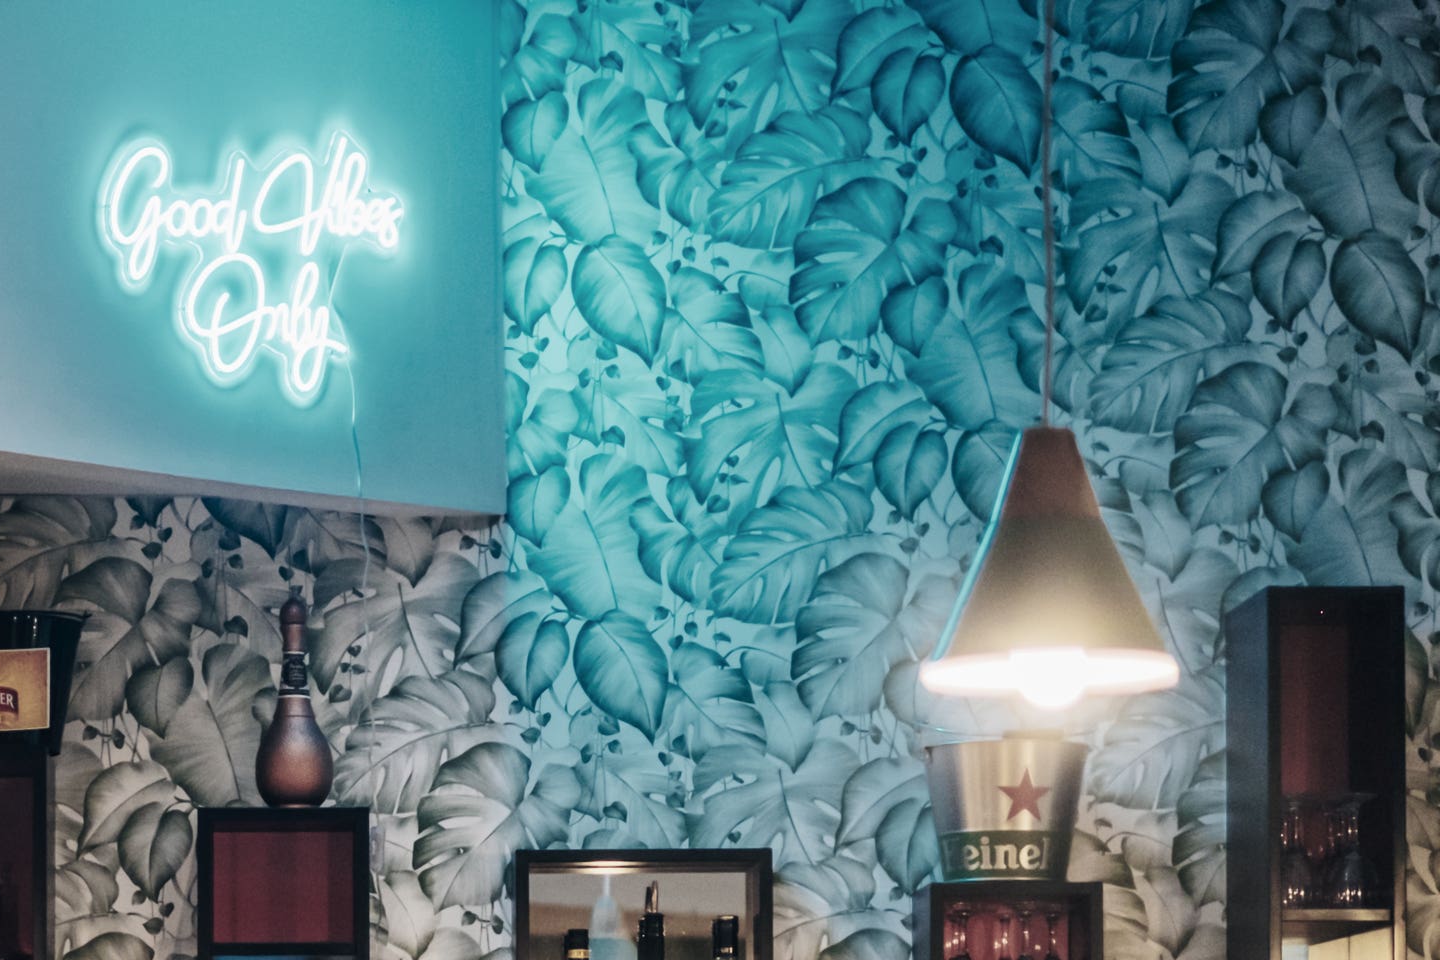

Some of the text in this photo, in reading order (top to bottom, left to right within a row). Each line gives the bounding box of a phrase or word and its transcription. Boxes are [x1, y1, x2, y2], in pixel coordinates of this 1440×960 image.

[110, 136, 404, 281] Good Vibes
[187, 252, 348, 392] Only
